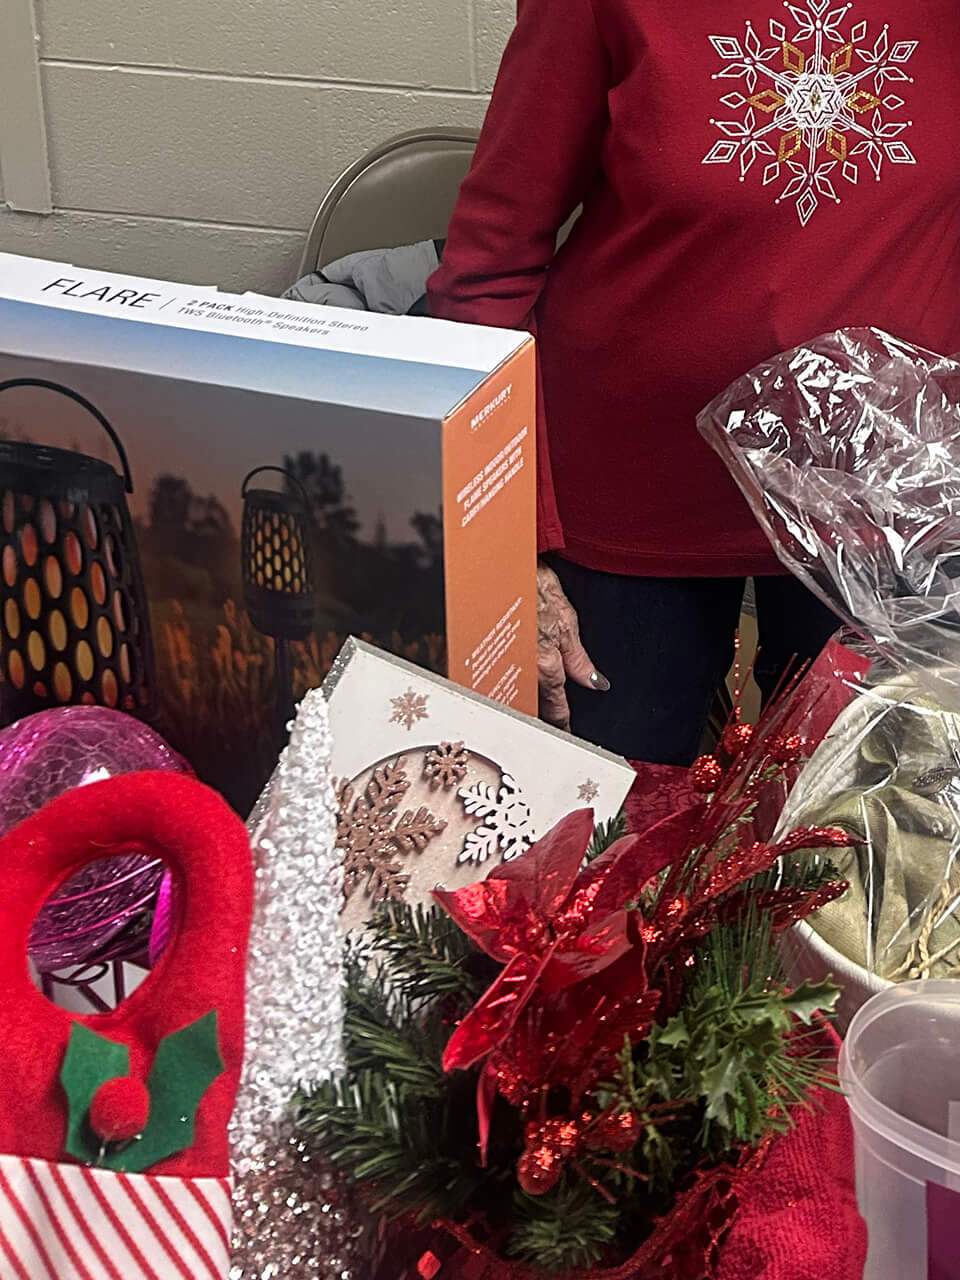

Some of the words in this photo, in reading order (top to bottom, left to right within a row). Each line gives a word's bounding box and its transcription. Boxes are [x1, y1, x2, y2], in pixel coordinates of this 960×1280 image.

[41, 277, 162, 309] FLARE
[193, 301, 234, 312] PACK
[234, 305, 326, 326] High-Definition
[328, 319, 369, 332] Stereo
[272, 321, 330, 335] Speakers
